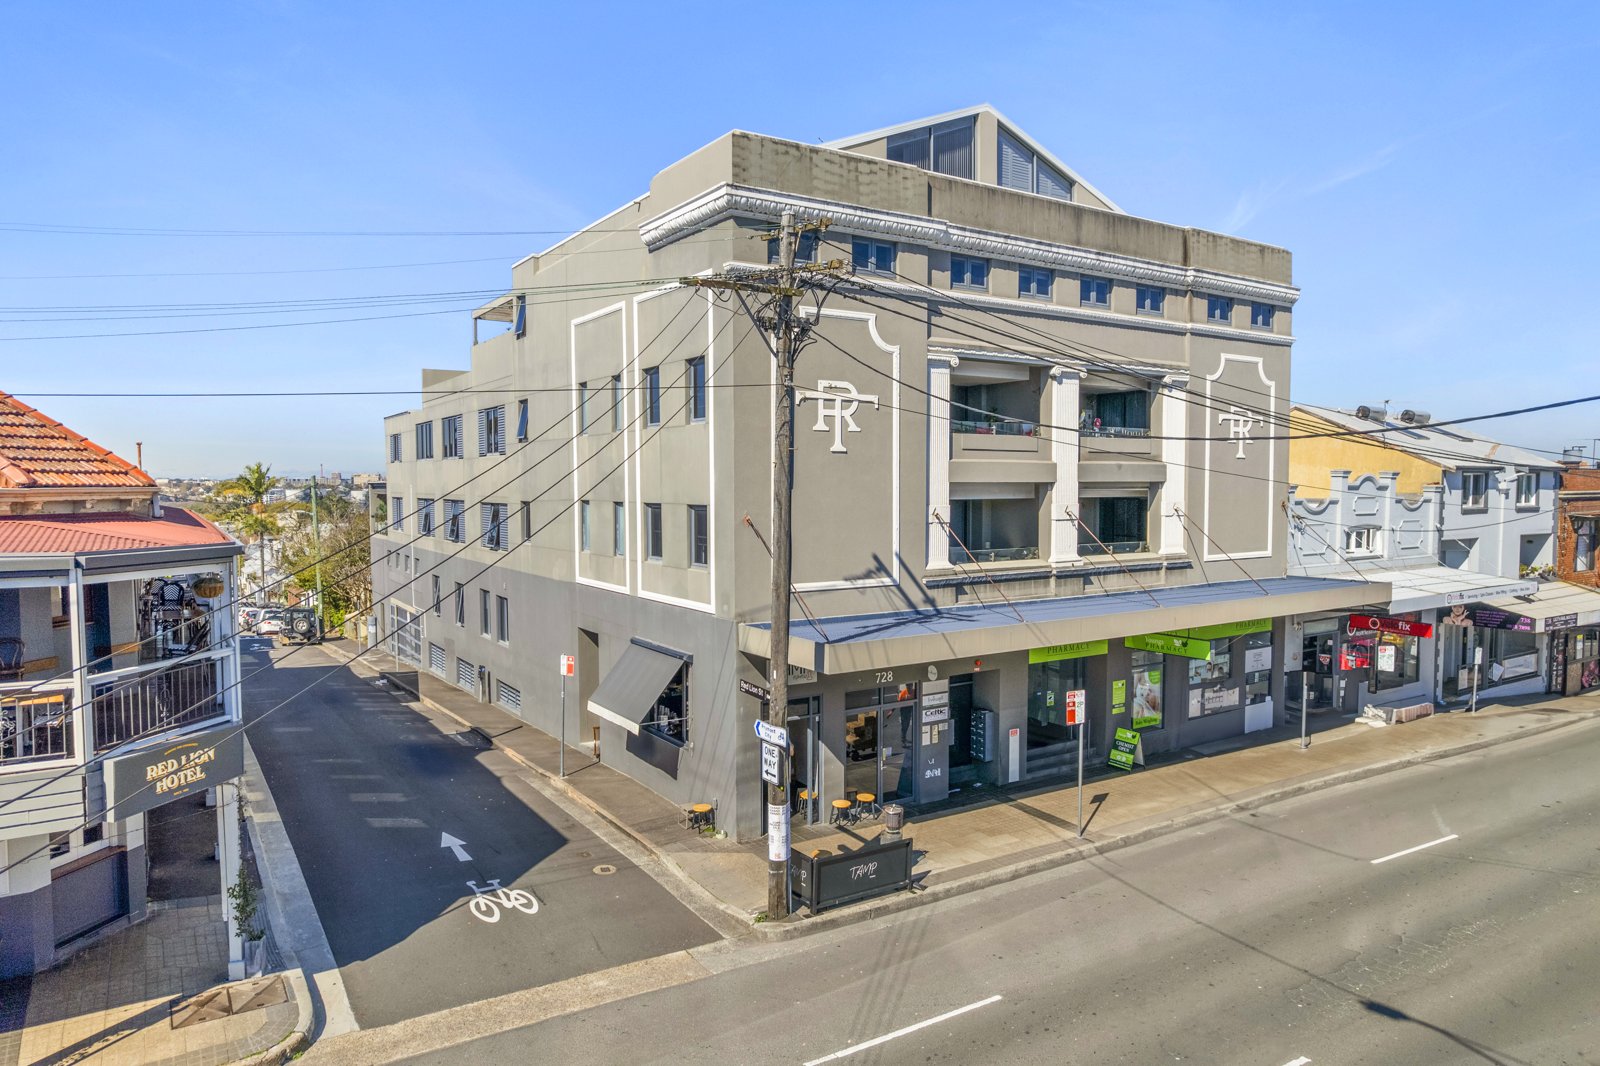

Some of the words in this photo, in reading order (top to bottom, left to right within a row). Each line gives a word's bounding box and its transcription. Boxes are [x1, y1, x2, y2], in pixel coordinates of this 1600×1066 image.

[1047, 643, 1089, 654] PHARMACY
[1146, 642, 1187, 654] PHARMACY
[875, 671, 894, 684] 728
[740, 680, 749, 691] Red
[749, 683, 758, 694] Lion
[758, 687, 764, 697] St
[924, 708, 946, 717] Celtic
[764, 746, 776, 759] ONE
[146, 758, 180, 782] RED
[181, 747, 216, 770] LION
[764, 757, 777, 770] WAY
[155, 765, 207, 795] HOTEL
[849, 861, 878, 880] TAMP
